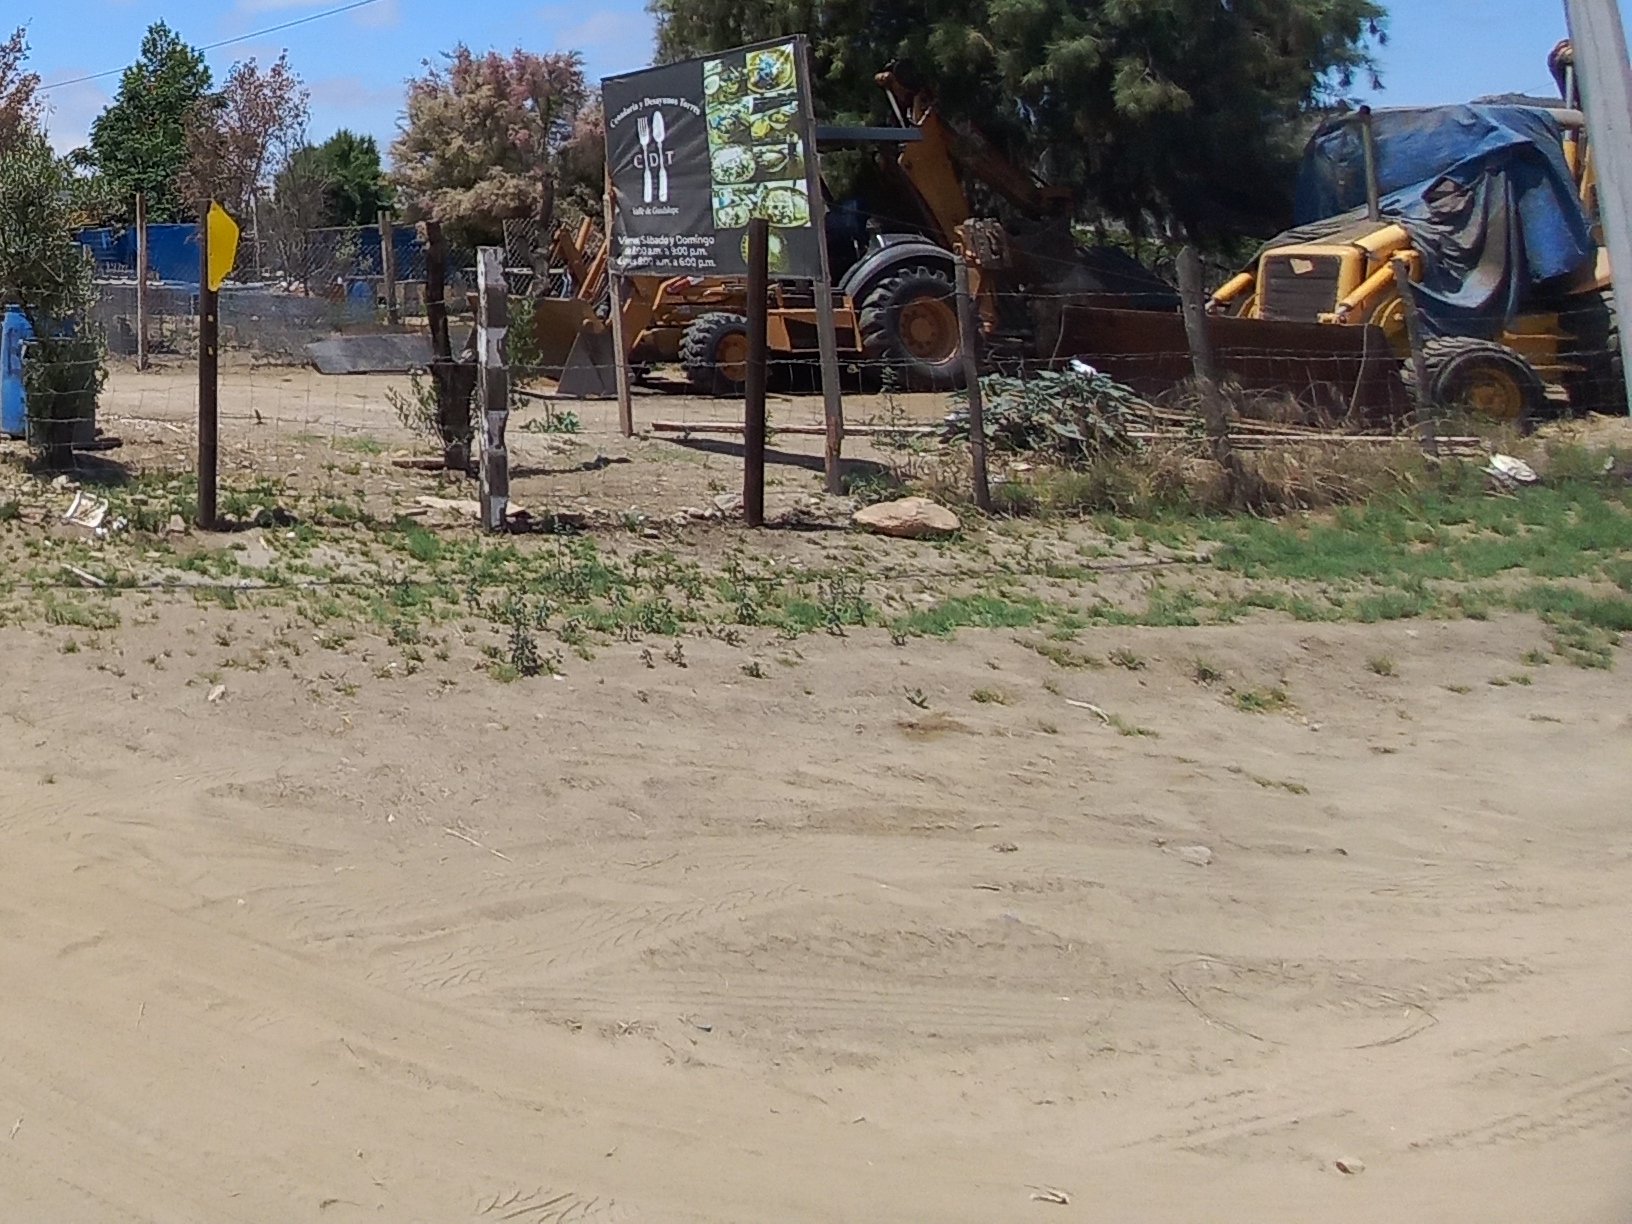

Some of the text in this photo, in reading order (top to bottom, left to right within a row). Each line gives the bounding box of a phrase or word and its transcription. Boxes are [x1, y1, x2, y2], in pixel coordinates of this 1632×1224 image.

[679, 97, 701, 116] Torres
[668, 237, 675, 246] y
[670, 246, 688, 256] 9:00
[689, 248, 708, 257] p.m.
[679, 257, 697, 267] 6:00
[698, 259, 716, 268] p.m.
